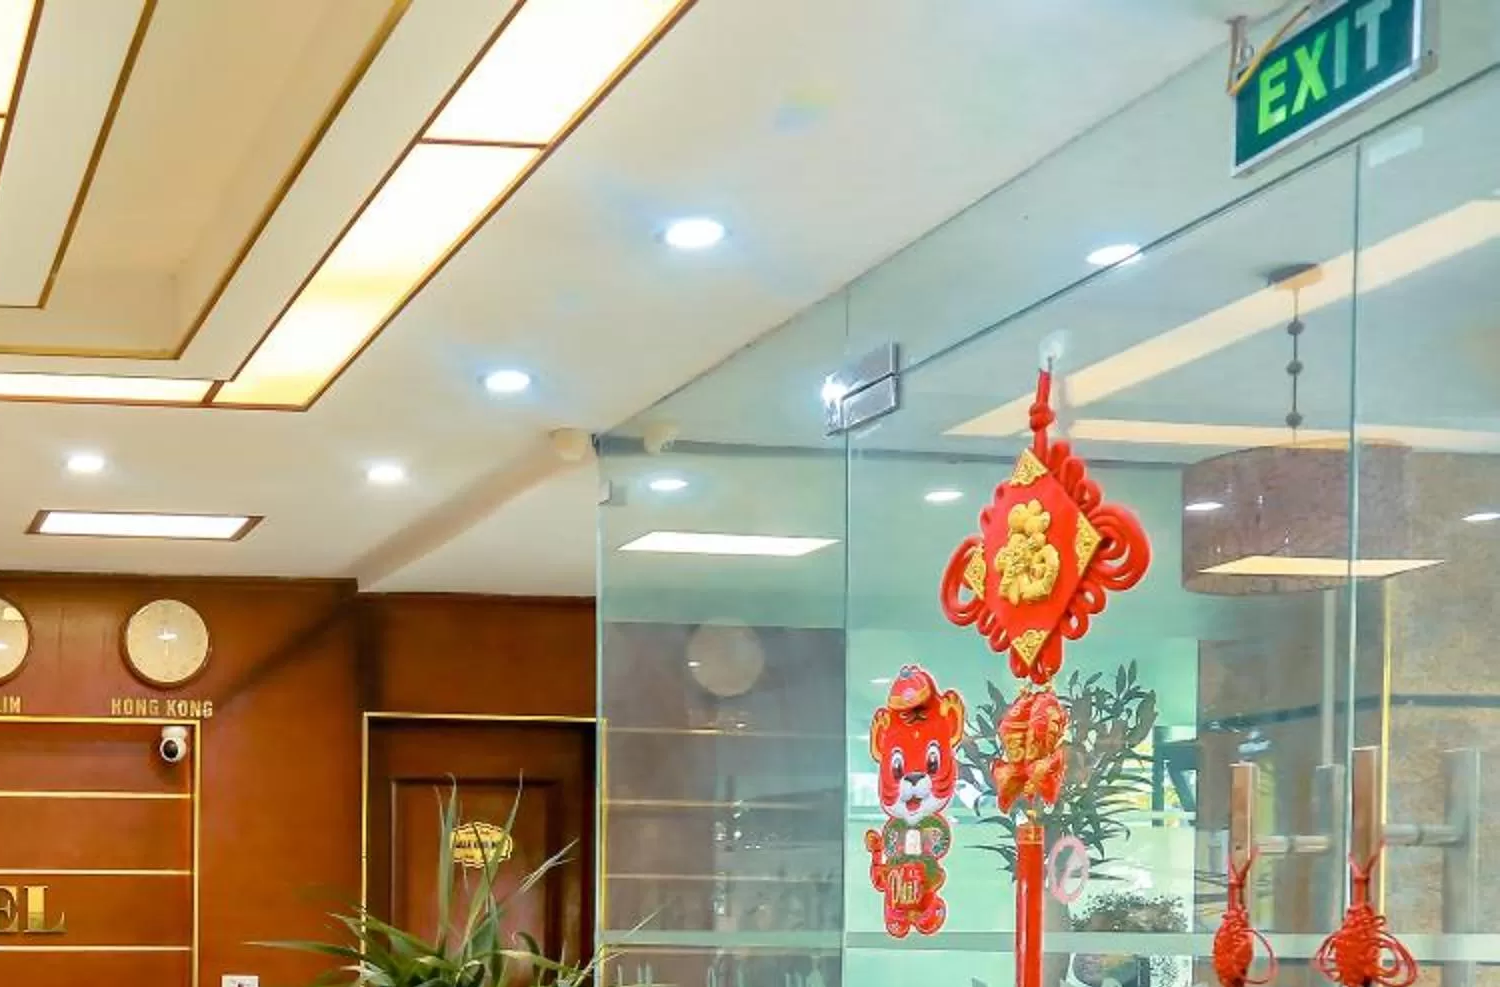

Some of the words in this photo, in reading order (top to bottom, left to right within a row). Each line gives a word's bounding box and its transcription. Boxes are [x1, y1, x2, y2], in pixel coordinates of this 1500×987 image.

[1257, 0, 1393, 135] EXIT
[111, 697, 160, 716] HONG
[165, 699, 213, 718] KONG
